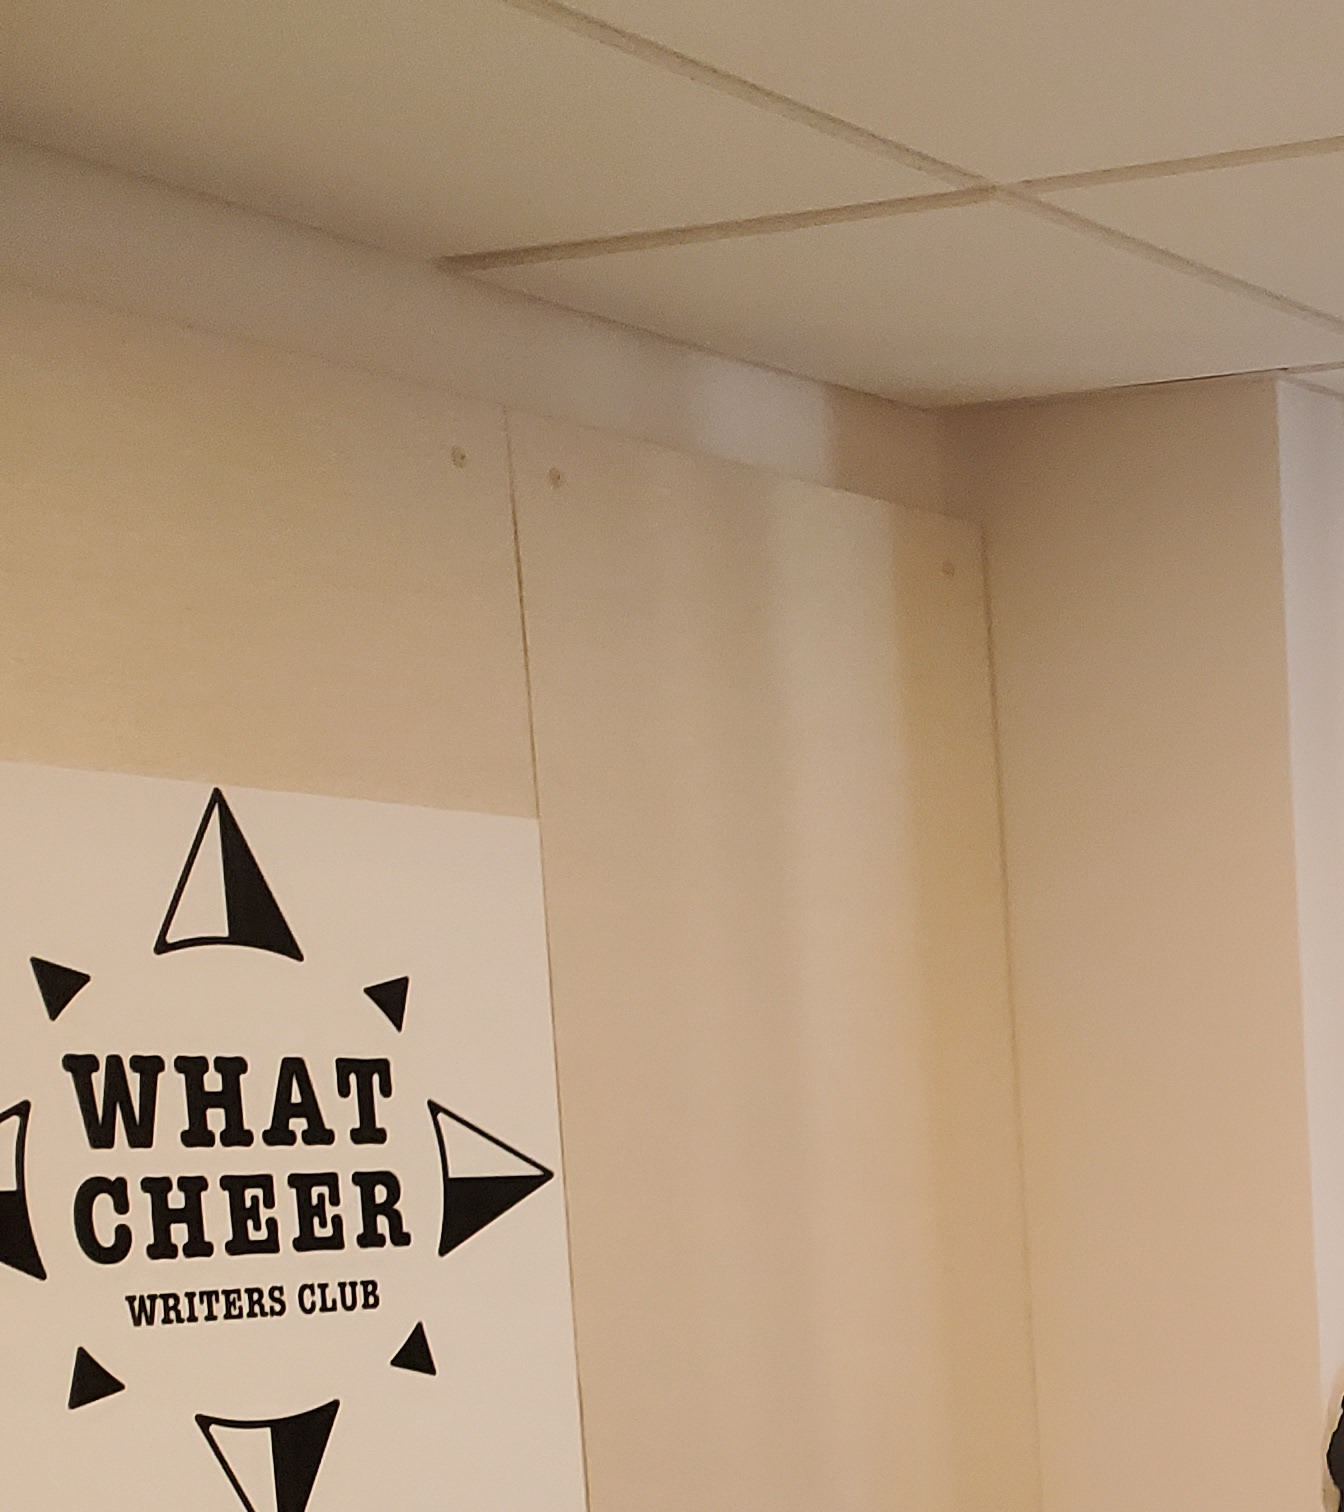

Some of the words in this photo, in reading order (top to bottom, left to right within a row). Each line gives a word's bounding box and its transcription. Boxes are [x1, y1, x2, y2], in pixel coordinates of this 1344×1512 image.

[62, 1053, 393, 1150] WHAT
[73, 1170, 412, 1265] CHEER
[125, 1285, 287, 1327] WRITERS
[298, 1279, 380, 1315] CLUB
